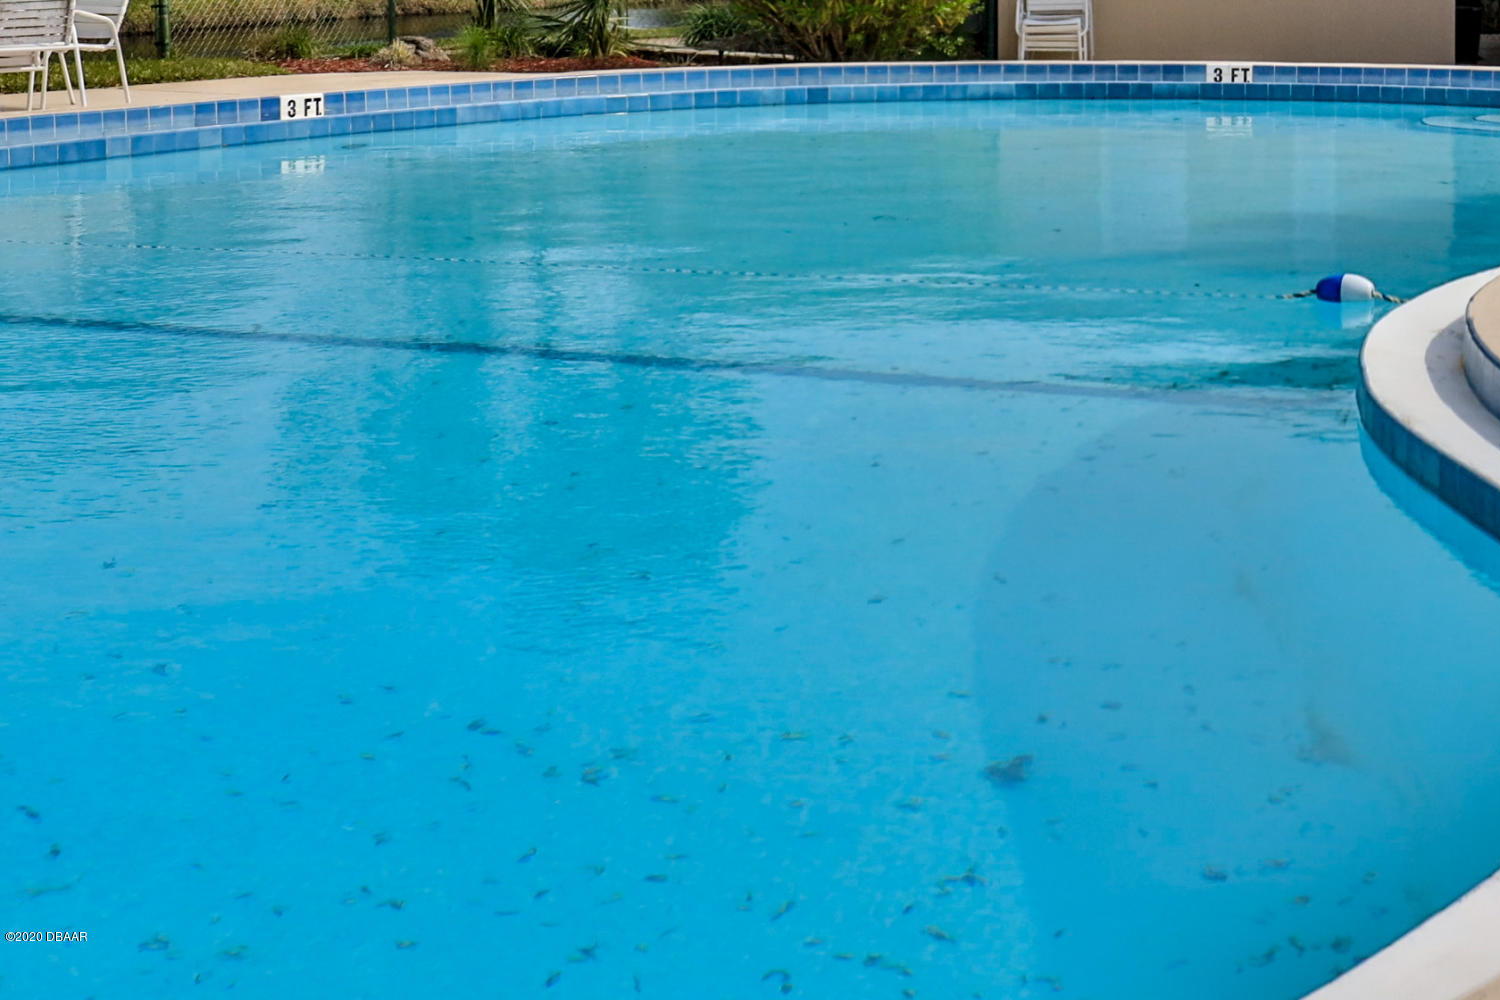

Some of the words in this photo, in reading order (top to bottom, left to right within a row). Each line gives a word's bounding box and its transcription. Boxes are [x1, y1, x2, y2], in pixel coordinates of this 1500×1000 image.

[1213, 67, 1223, 83] 3
[1231, 67, 1250, 83] FT.
[287, 99, 296, 118] 3
[304, 97, 322, 117] FT.
